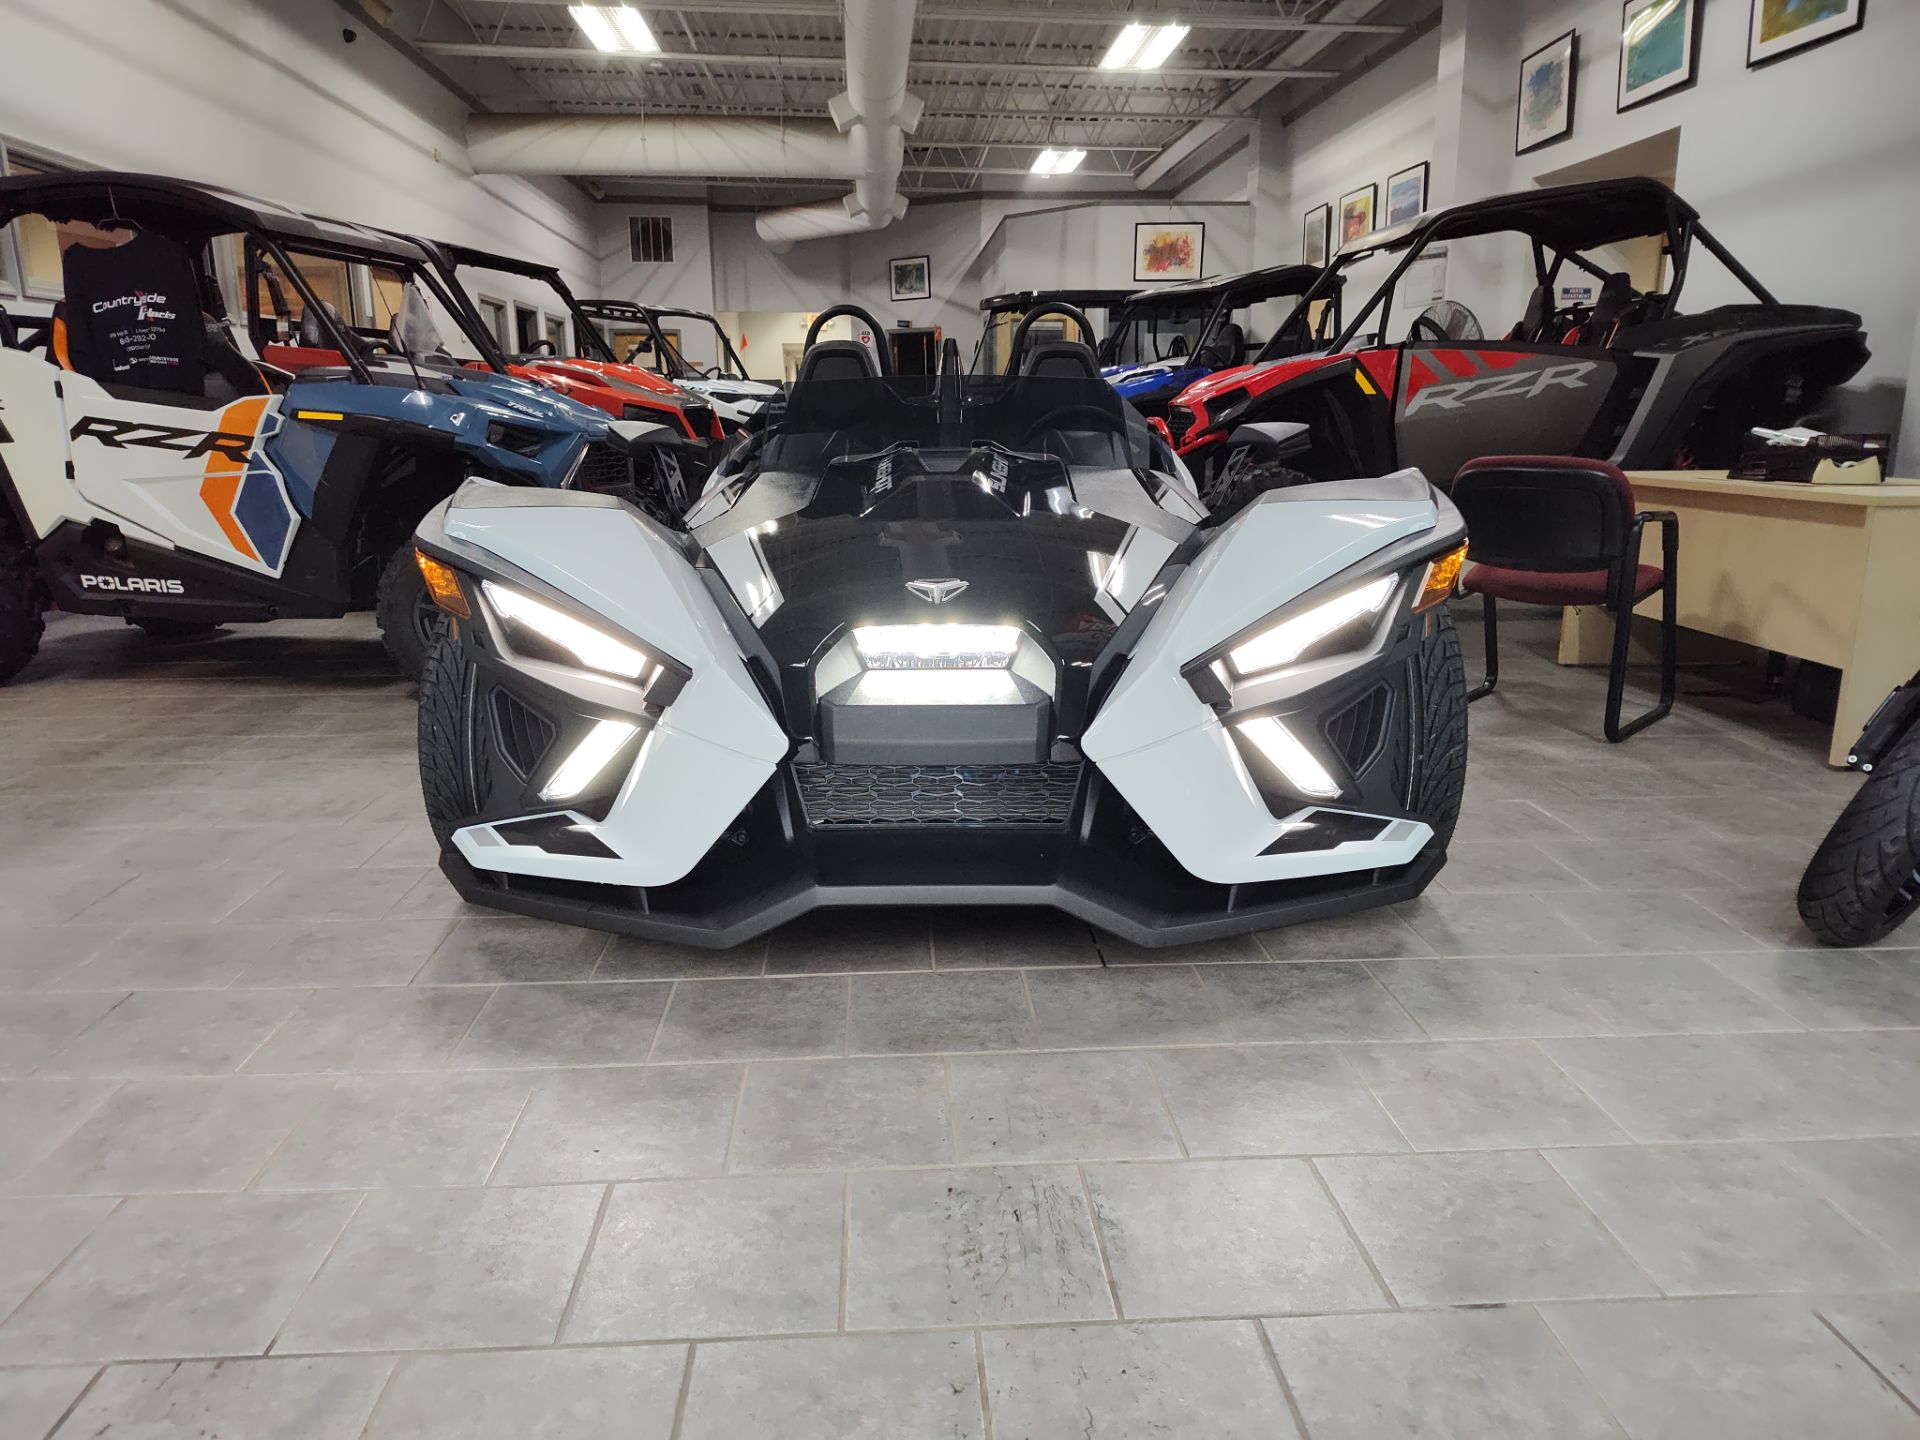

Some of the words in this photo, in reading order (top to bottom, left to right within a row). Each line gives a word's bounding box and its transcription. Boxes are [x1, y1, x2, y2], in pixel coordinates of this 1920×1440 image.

[1404, 361, 1597, 417] RZR
[70, 416, 255, 464] RZR
[80, 574, 185, 594] POLARIS
